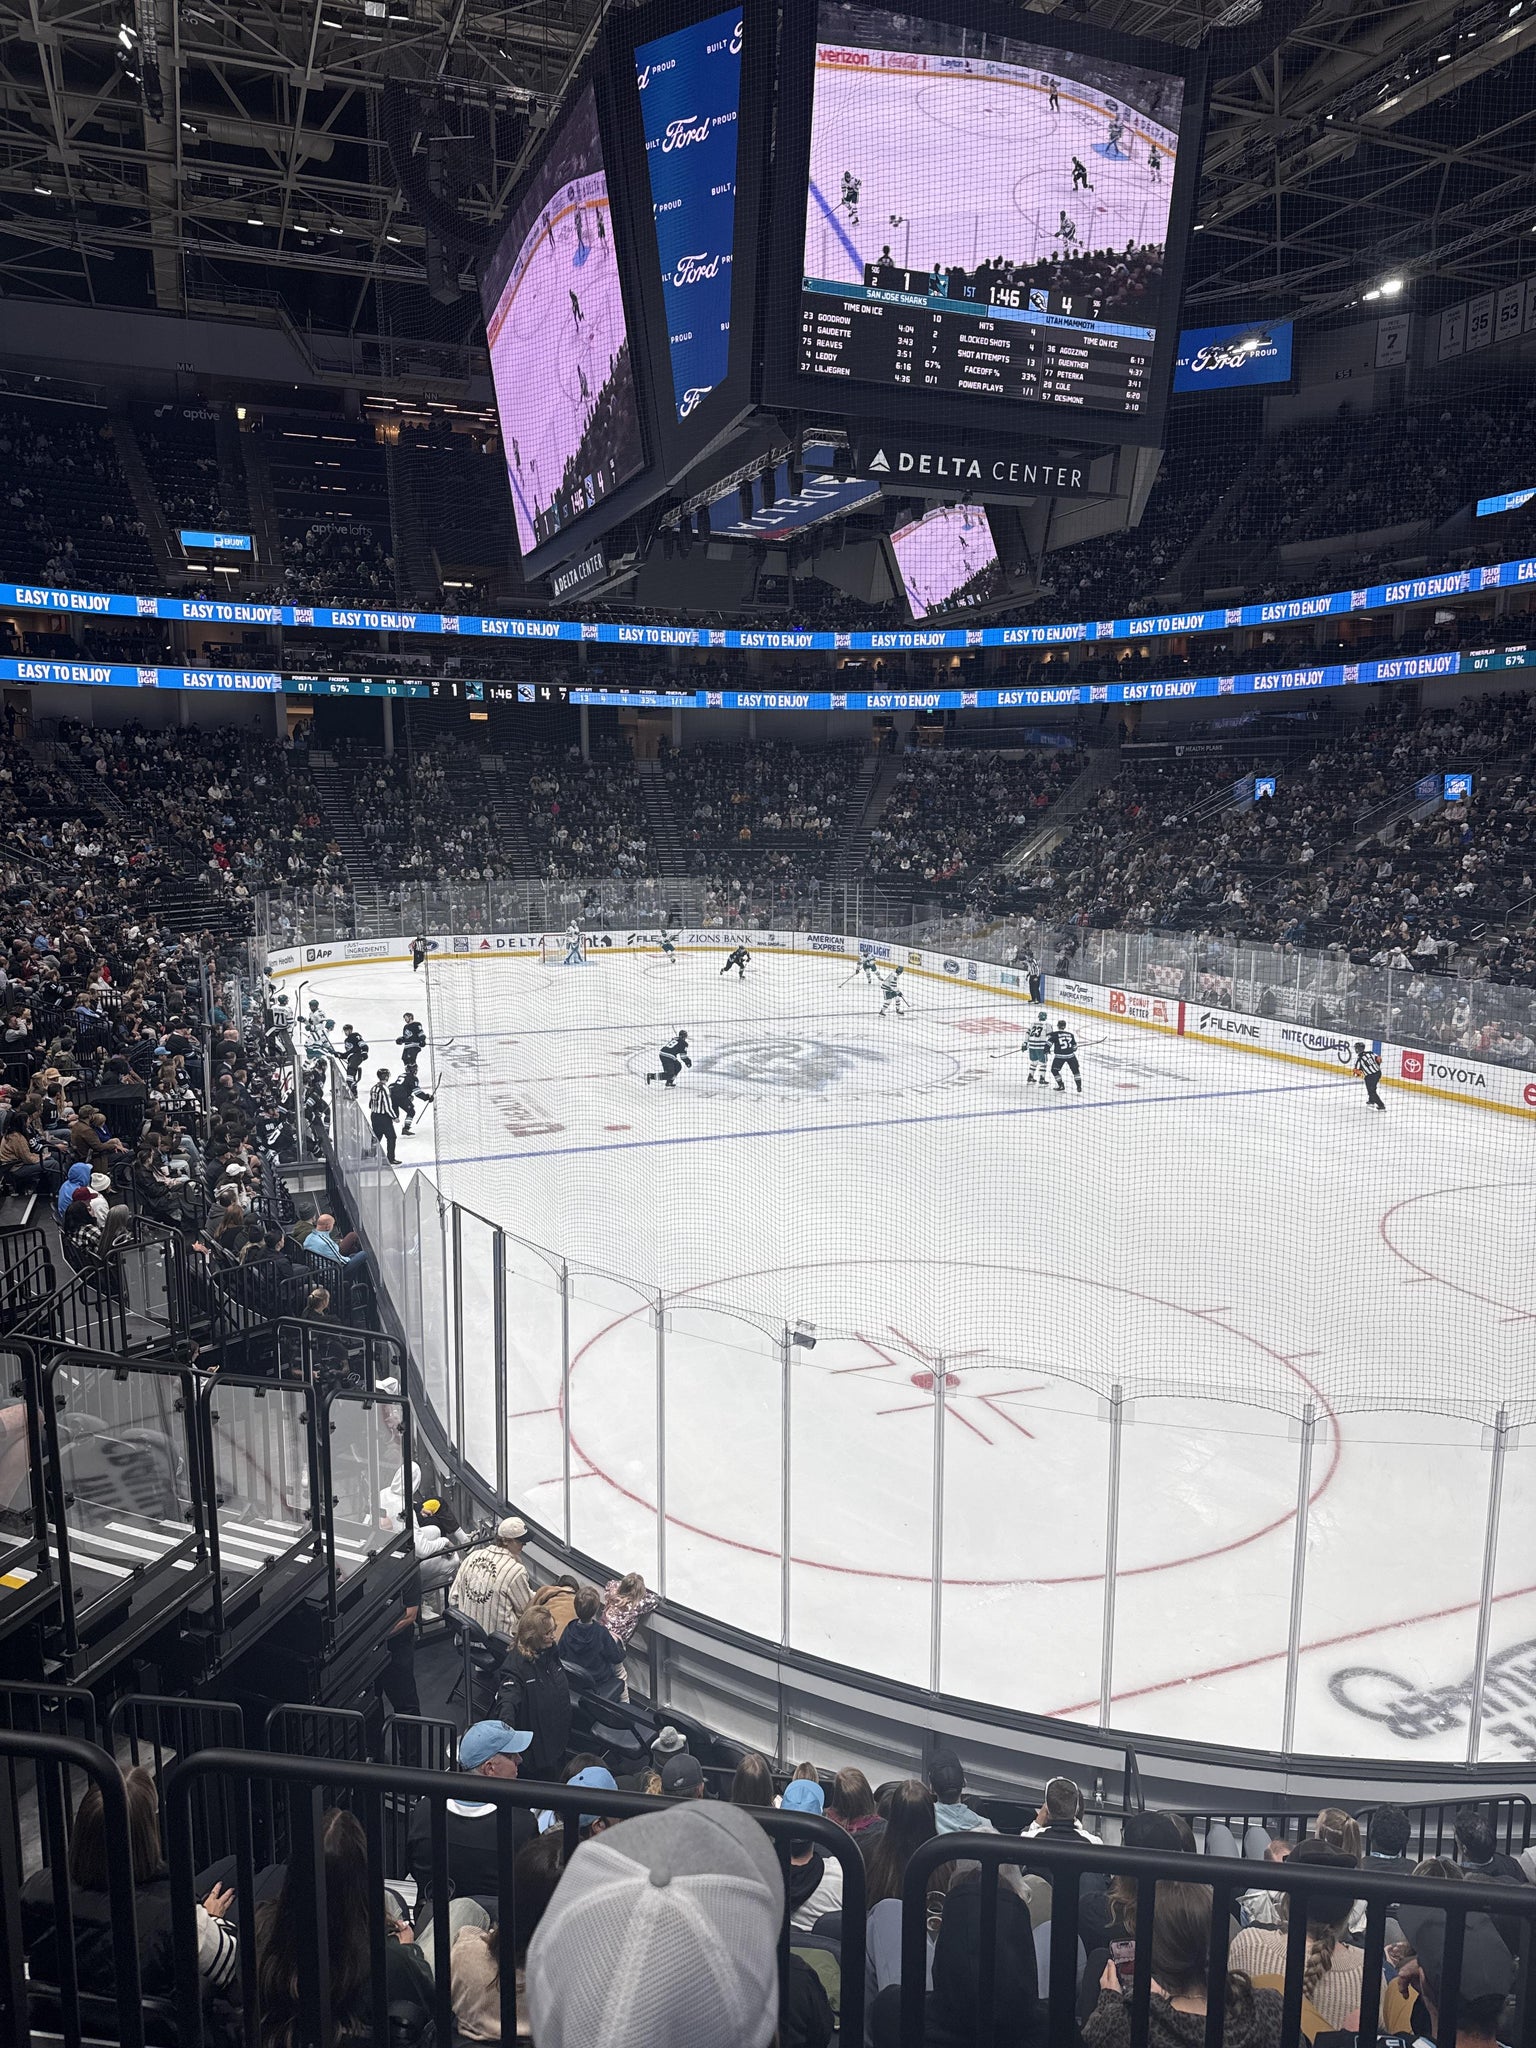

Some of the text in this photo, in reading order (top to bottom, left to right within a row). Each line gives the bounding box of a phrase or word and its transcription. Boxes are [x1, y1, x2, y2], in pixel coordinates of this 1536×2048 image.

[706, 39, 727, 54] BUILT
[819, 48, 869, 65] verizon
[652, 59, 676, 75] PROUD
[645, 112, 737, 153] UILT Ford PROUD
[712, 182, 731, 196] BUILT
[660, 199, 682, 212] PROUD
[674, 252, 719, 287] Ford
[872, 277, 878, 286] 2
[904, 273, 910, 291] 1
[866, 290, 927, 305] SAN JOSE SHARKS
[964, 286, 976, 298] 1ST
[990, 286, 1020, 307] 1:46
[844, 302, 883, 316] TIME ON ICE
[1062, 296, 1072, 314] 4
[1501, 303, 1518, 322] 53
[1093, 310, 1099, 318] 7
[804, 311, 914, 333] 23 GOODROW 4:04
[933, 314, 1036, 336] 10 HITS 4
[1046, 316, 1095, 330] UTAH MAMMOTH
[1472, 313, 1489, 333] 35
[671, 332, 692, 343] PROUD
[803, 324, 914, 346] 81 GAUDETTE 3:43
[960, 334, 988, 345] BLOCKED
[990, 338, 1010, 348] SHOTS
[1083, 336, 1098, 346] TIME
[1108, 341, 1119, 349] ICE
[1387, 334, 1398, 349] 7
[802, 337, 912, 358] 75 REAVES 3:51
[1047, 345, 1145, 365] 36 AGOZZINO 6:13
[806, 350, 911, 371] 4 LEDDY 6:16
[958, 349, 974, 359] SHOT
[976, 351, 1010, 364] ATTEMPTS
[1027, 359, 1035, 367] 13
[1191, 346, 1278, 372] Ford PROUD
[814, 365, 850, 376] LILJEGREN
[895, 374, 911, 383] 4:36
[925, 360, 1036, 381] 67% FACEOFF % 33%
[1058, 359, 1089, 370] GUENTHER
[1129, 369, 1143, 377] 4:37
[925, 375, 1033, 396] 0/1 POWER PLAYS 1/1
[1045, 369, 1142, 388] 77 PETERKA 3:41
[1056, 383, 1071, 391] COLE
[1126, 392, 1140, 400] 6:20
[1055, 394, 1084, 404] DESIMONE
[1125, 403, 1139, 411] 3:10
[183, 409, 220, 421] aptive
[898, 452, 1082, 487] DELTA CENTER
[597, 470, 605, 493] 4
[728, 489, 840, 530] DELTA
[312, 522, 372, 537] aptive lofts
[559, 553, 604, 592] DELTA CENTER
[1483, 566, 1499, 577] BUD
[1386, 574, 1461, 602] EASY TO ENJOY
[16, 589, 110, 611] EASY TO ENJOY
[139, 599, 156, 607] BUD
[482, 620, 560, 636] EASY TO ENJOY
[872, 633, 945, 646] EASY TO ENJOY
[17, 663, 111, 682] EASY TO ENJOY
[1377, 656, 1452, 678] EASY TO ENJOY
[298, 683, 312, 692] 0/1
[330, 685, 349, 693] 67%
[433, 687, 438, 695] 2
[452, 684, 457, 696] 1
[490, 688, 512, 699] 1:46
[541, 688, 551, 700] 4
[496, 938, 545, 948] DELTA
[637, 935, 679, 943] FILEE
[688, 934, 752, 943] ZIONS BANK
[807, 935, 844, 944] AMERICAN
[347, 946, 386, 954] INGREDIENTS
[813, 944, 845, 952] EXPRESS
[860, 943, 890, 957] BUD LIGHT
[1060, 991, 1094, 1003] AMERICA FIRST
[1129, 996, 1149, 1007] PEANUT
[274, 1013, 285, 1025] 71
[1129, 1006, 1149, 1018] BETTER
[1030, 1026, 1043, 1037] 23
[1211, 1017, 1260, 1038] FILEVINE
[1282, 1028, 1351, 1060] NITECRAWLER
[1429, 1063, 1485, 1088] TOYOTA
